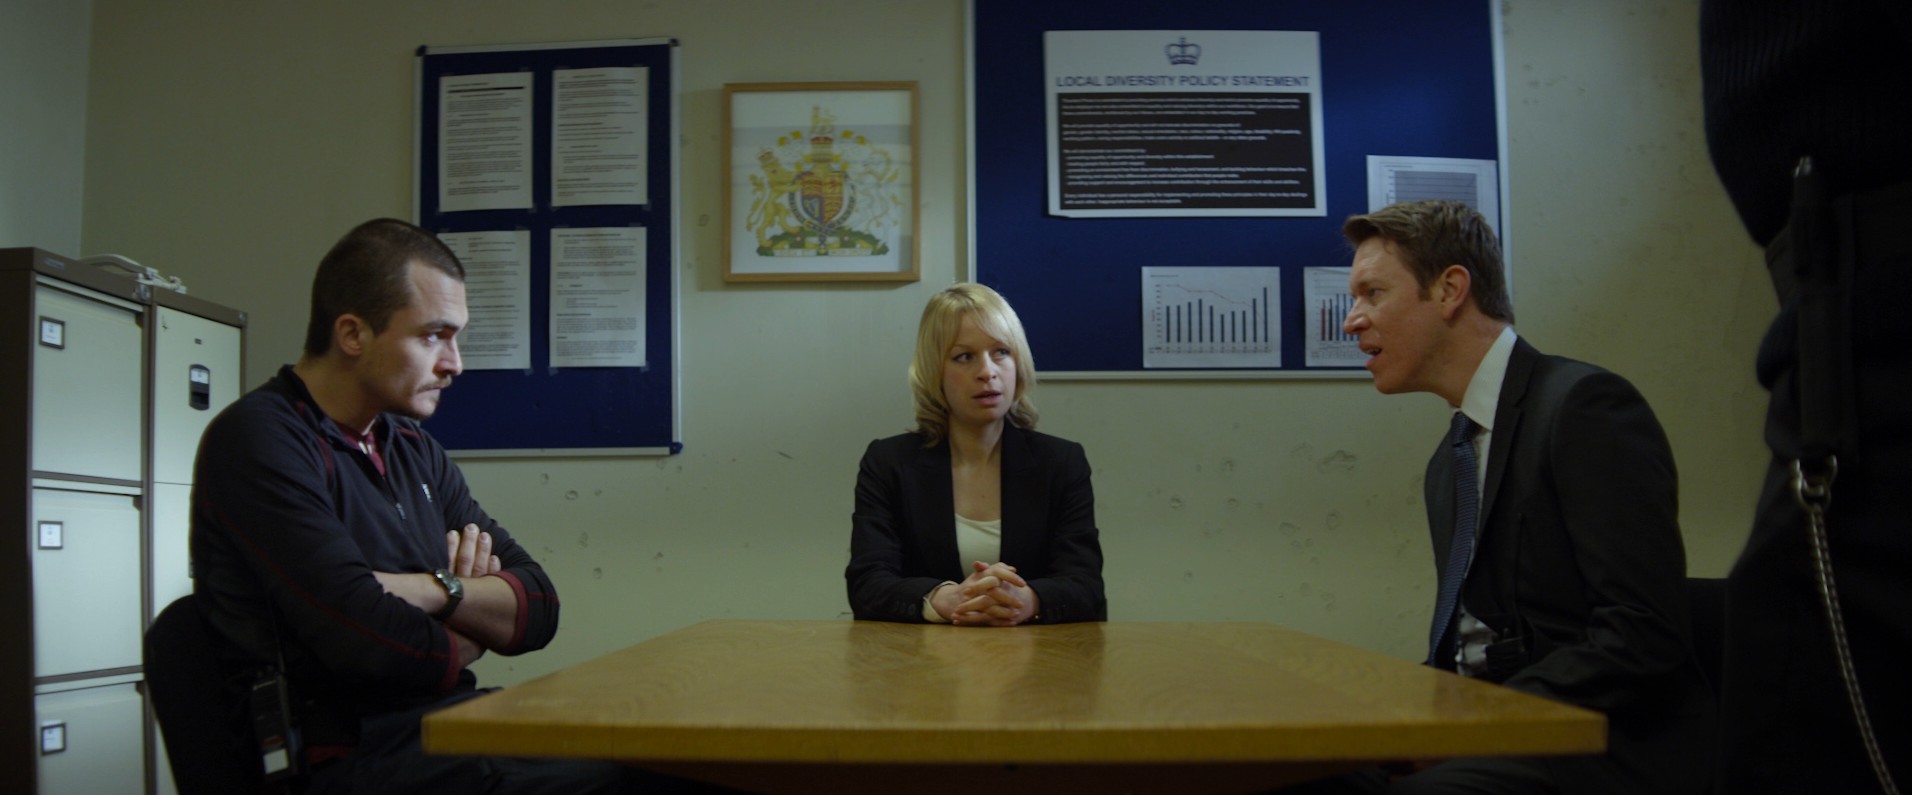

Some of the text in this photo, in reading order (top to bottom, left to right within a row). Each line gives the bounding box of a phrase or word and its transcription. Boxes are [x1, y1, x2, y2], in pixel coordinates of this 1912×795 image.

[1056, 76, 1310, 87] LOCAL DIVERSITY POLICY STATEMENT
